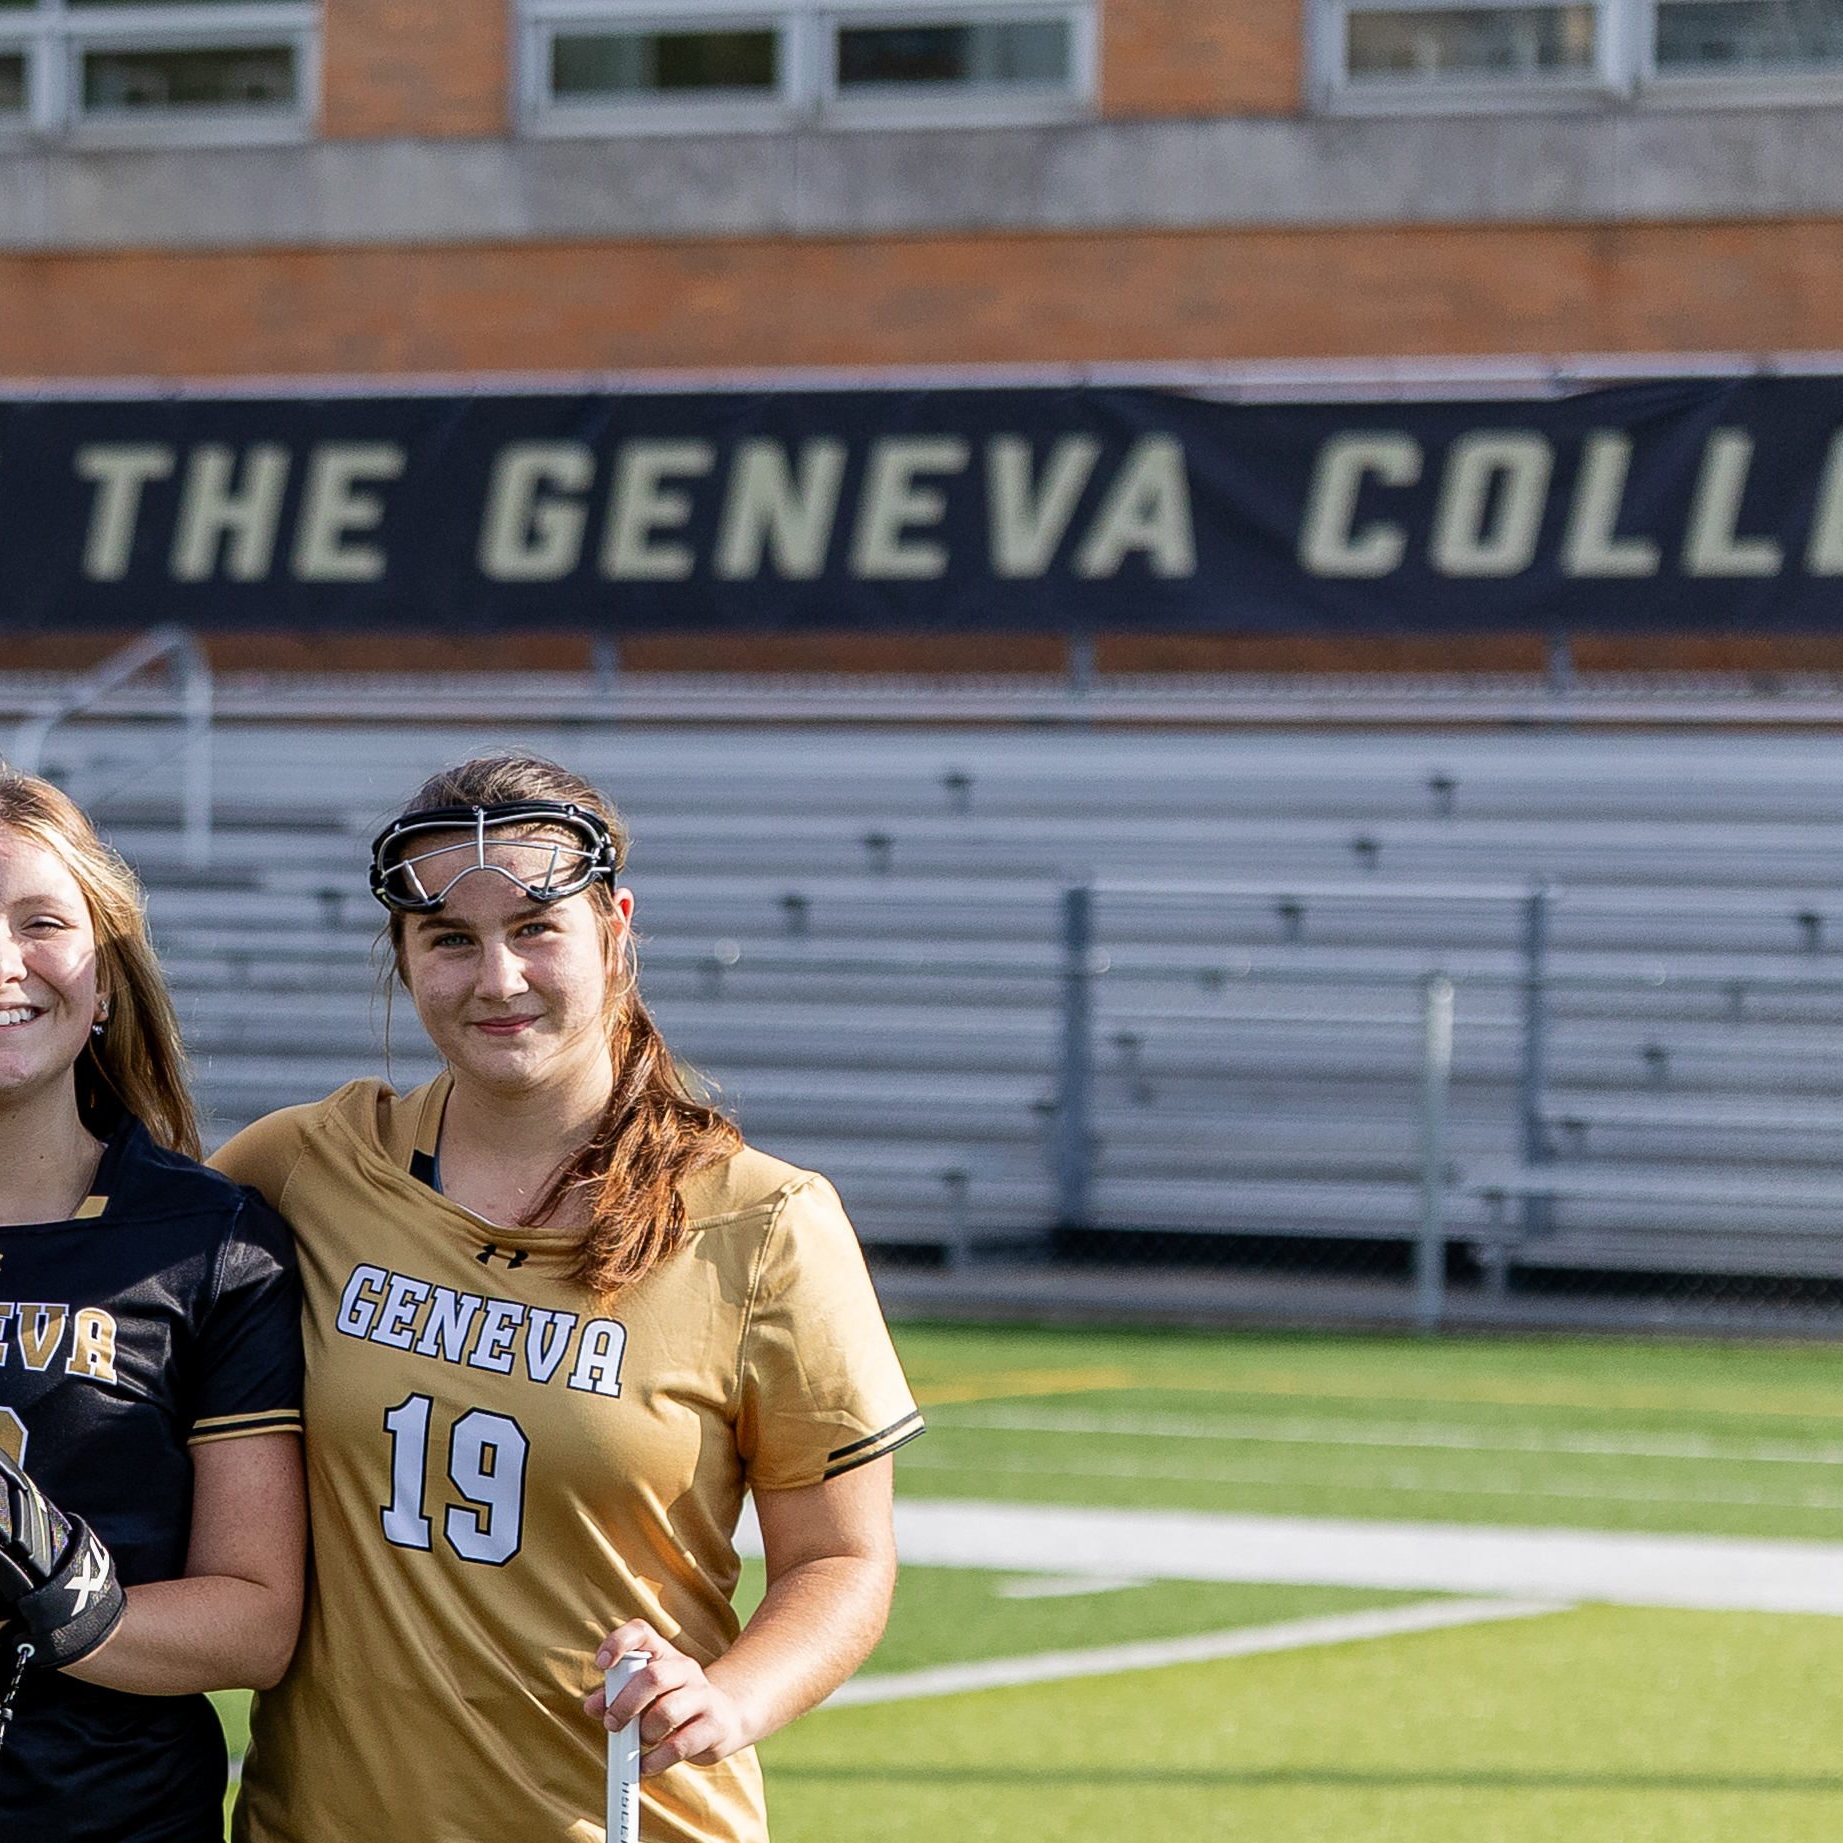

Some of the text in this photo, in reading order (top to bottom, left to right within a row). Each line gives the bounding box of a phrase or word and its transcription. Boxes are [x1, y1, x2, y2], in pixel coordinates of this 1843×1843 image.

[75, 443, 406, 582] THE
[476, 434, 1198, 582] GENEVA
[336, 1263, 627, 1399] GENEVA
[380, 1392, 530, 1568] 19
[64, 1530, 111, 1617] TX
